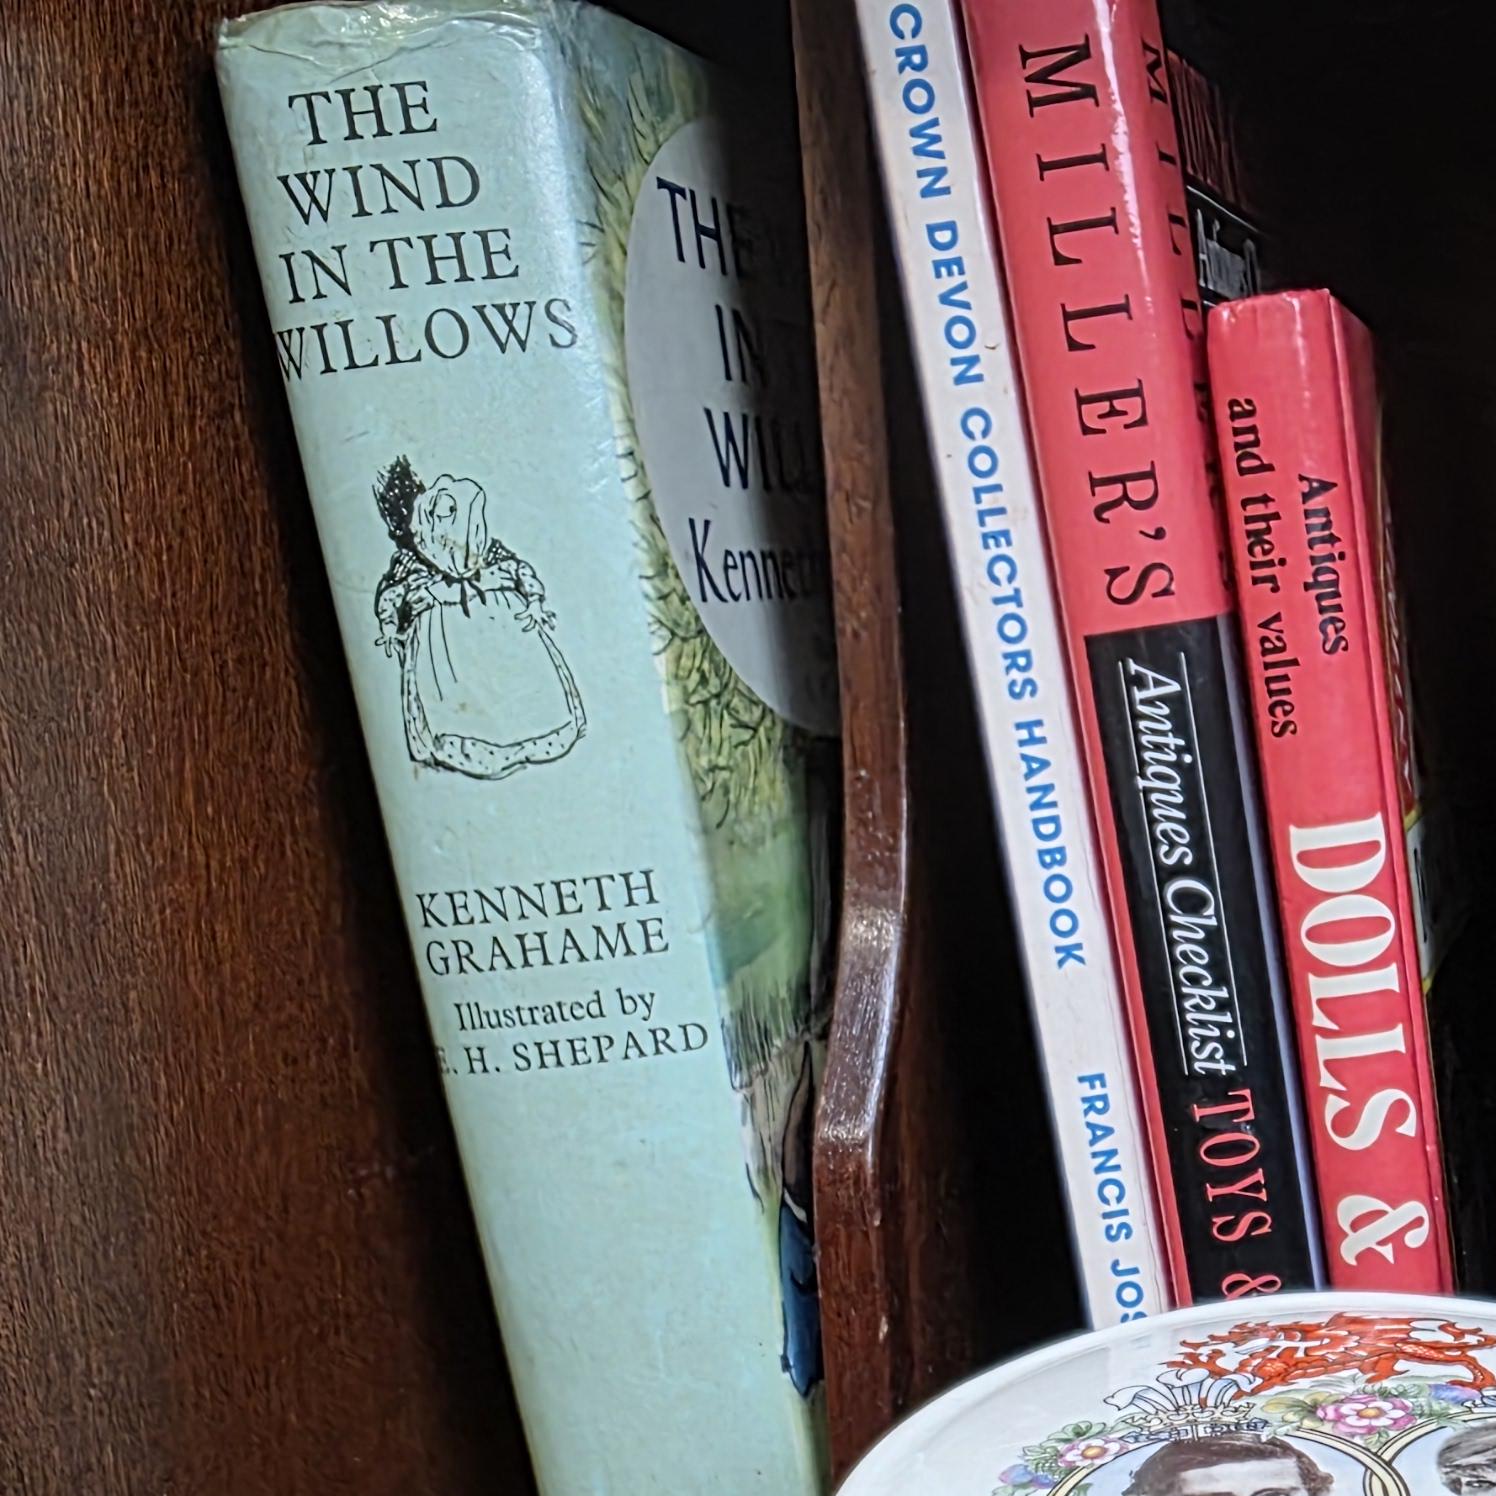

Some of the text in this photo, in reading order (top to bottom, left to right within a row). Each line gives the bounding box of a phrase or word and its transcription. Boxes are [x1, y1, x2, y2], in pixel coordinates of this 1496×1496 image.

[288, 80, 438, 146] THE
[276, 155, 481, 227] WIND
[656, 176, 752, 278] THE
[279, 228, 520, 304] IN THE
[275, 298, 578, 382] WILLOWS
[1018, 33, 1176, 606] MILLER'S
[1228, 397, 1300, 740] and their values
[1297, 473, 1349, 656] Antiques
[889, 3, 952, 199] CROWN
[925, 220, 985, 387] DEVON
[960, 407, 1038, 702] COLLECTORS
[1014, 718, 1087, 970] HANDBOOK
[1076, 1071, 1133, 1243] FRANCIS
[1132, 656, 1193, 867] Antiques
[416, 869, 659, 929] KENNETH
[425, 917, 671, 976] GRAHAME
[454, 988, 656, 1032] Illustrated by
[1163, 877, 1234, 1076] Checklist
[463, 1045, 501, 1075] H.
[512, 1022, 709, 1072] SHEPARD
[1288, 810, 1429, 1267] DOLLS &
[1192, 1087, 1273, 1242] TOYS
